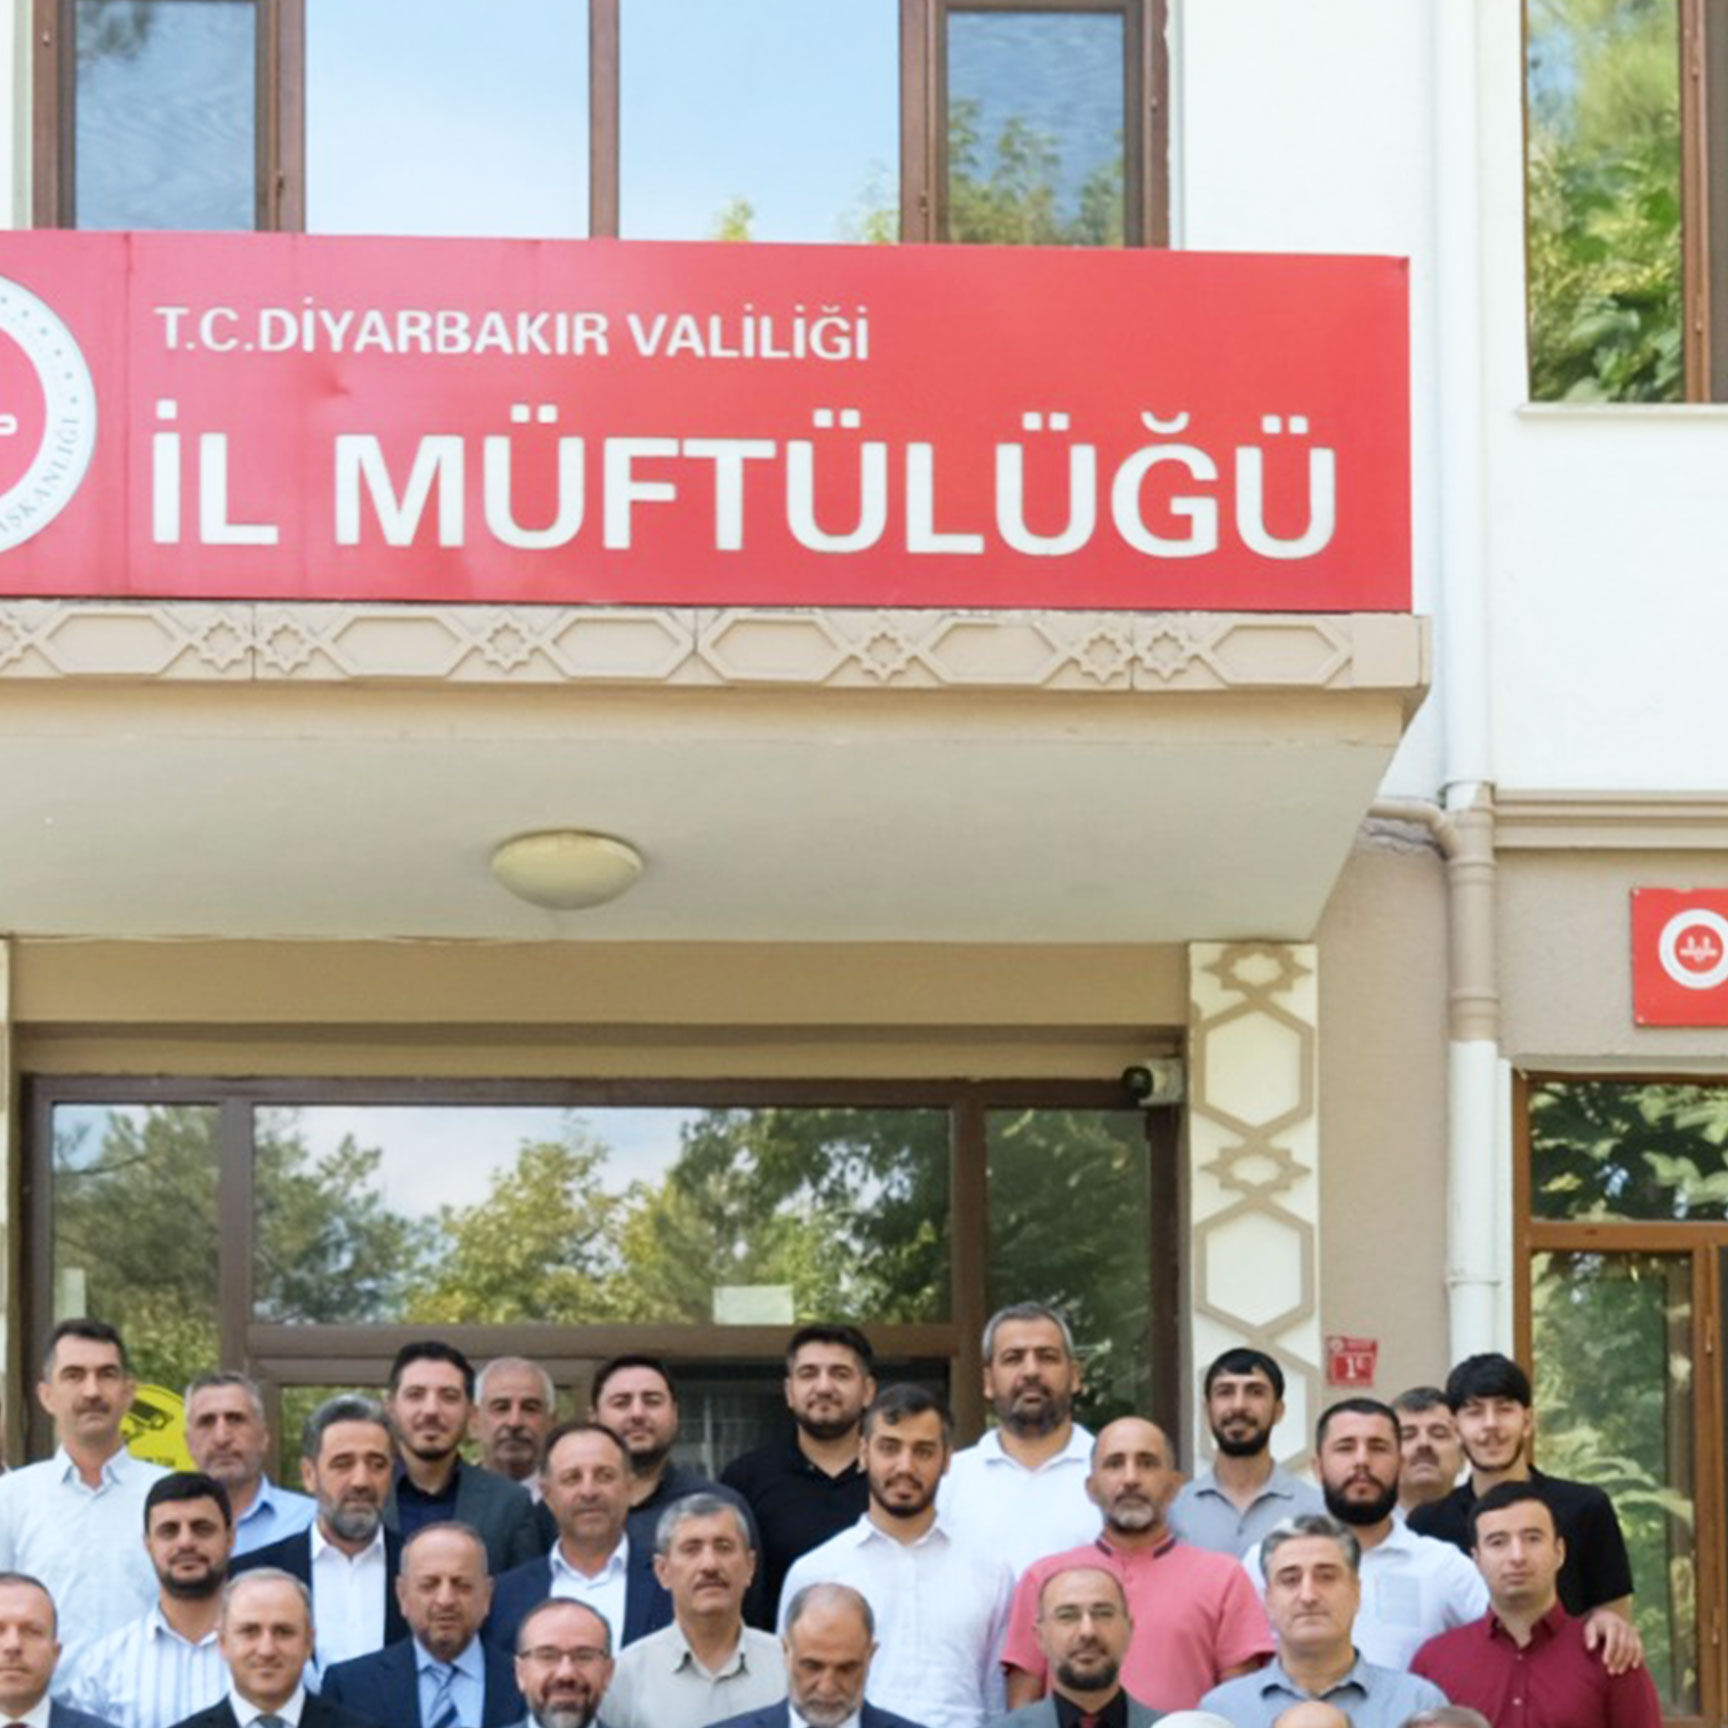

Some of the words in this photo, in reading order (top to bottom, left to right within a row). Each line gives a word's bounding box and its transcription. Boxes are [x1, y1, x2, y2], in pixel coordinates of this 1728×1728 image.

[626, 302, 869, 361] VALİLİĞİ
[152, 398, 280, 546] İL
[334, 403, 1337, 561] MÜFTÜLÜĞÜ
